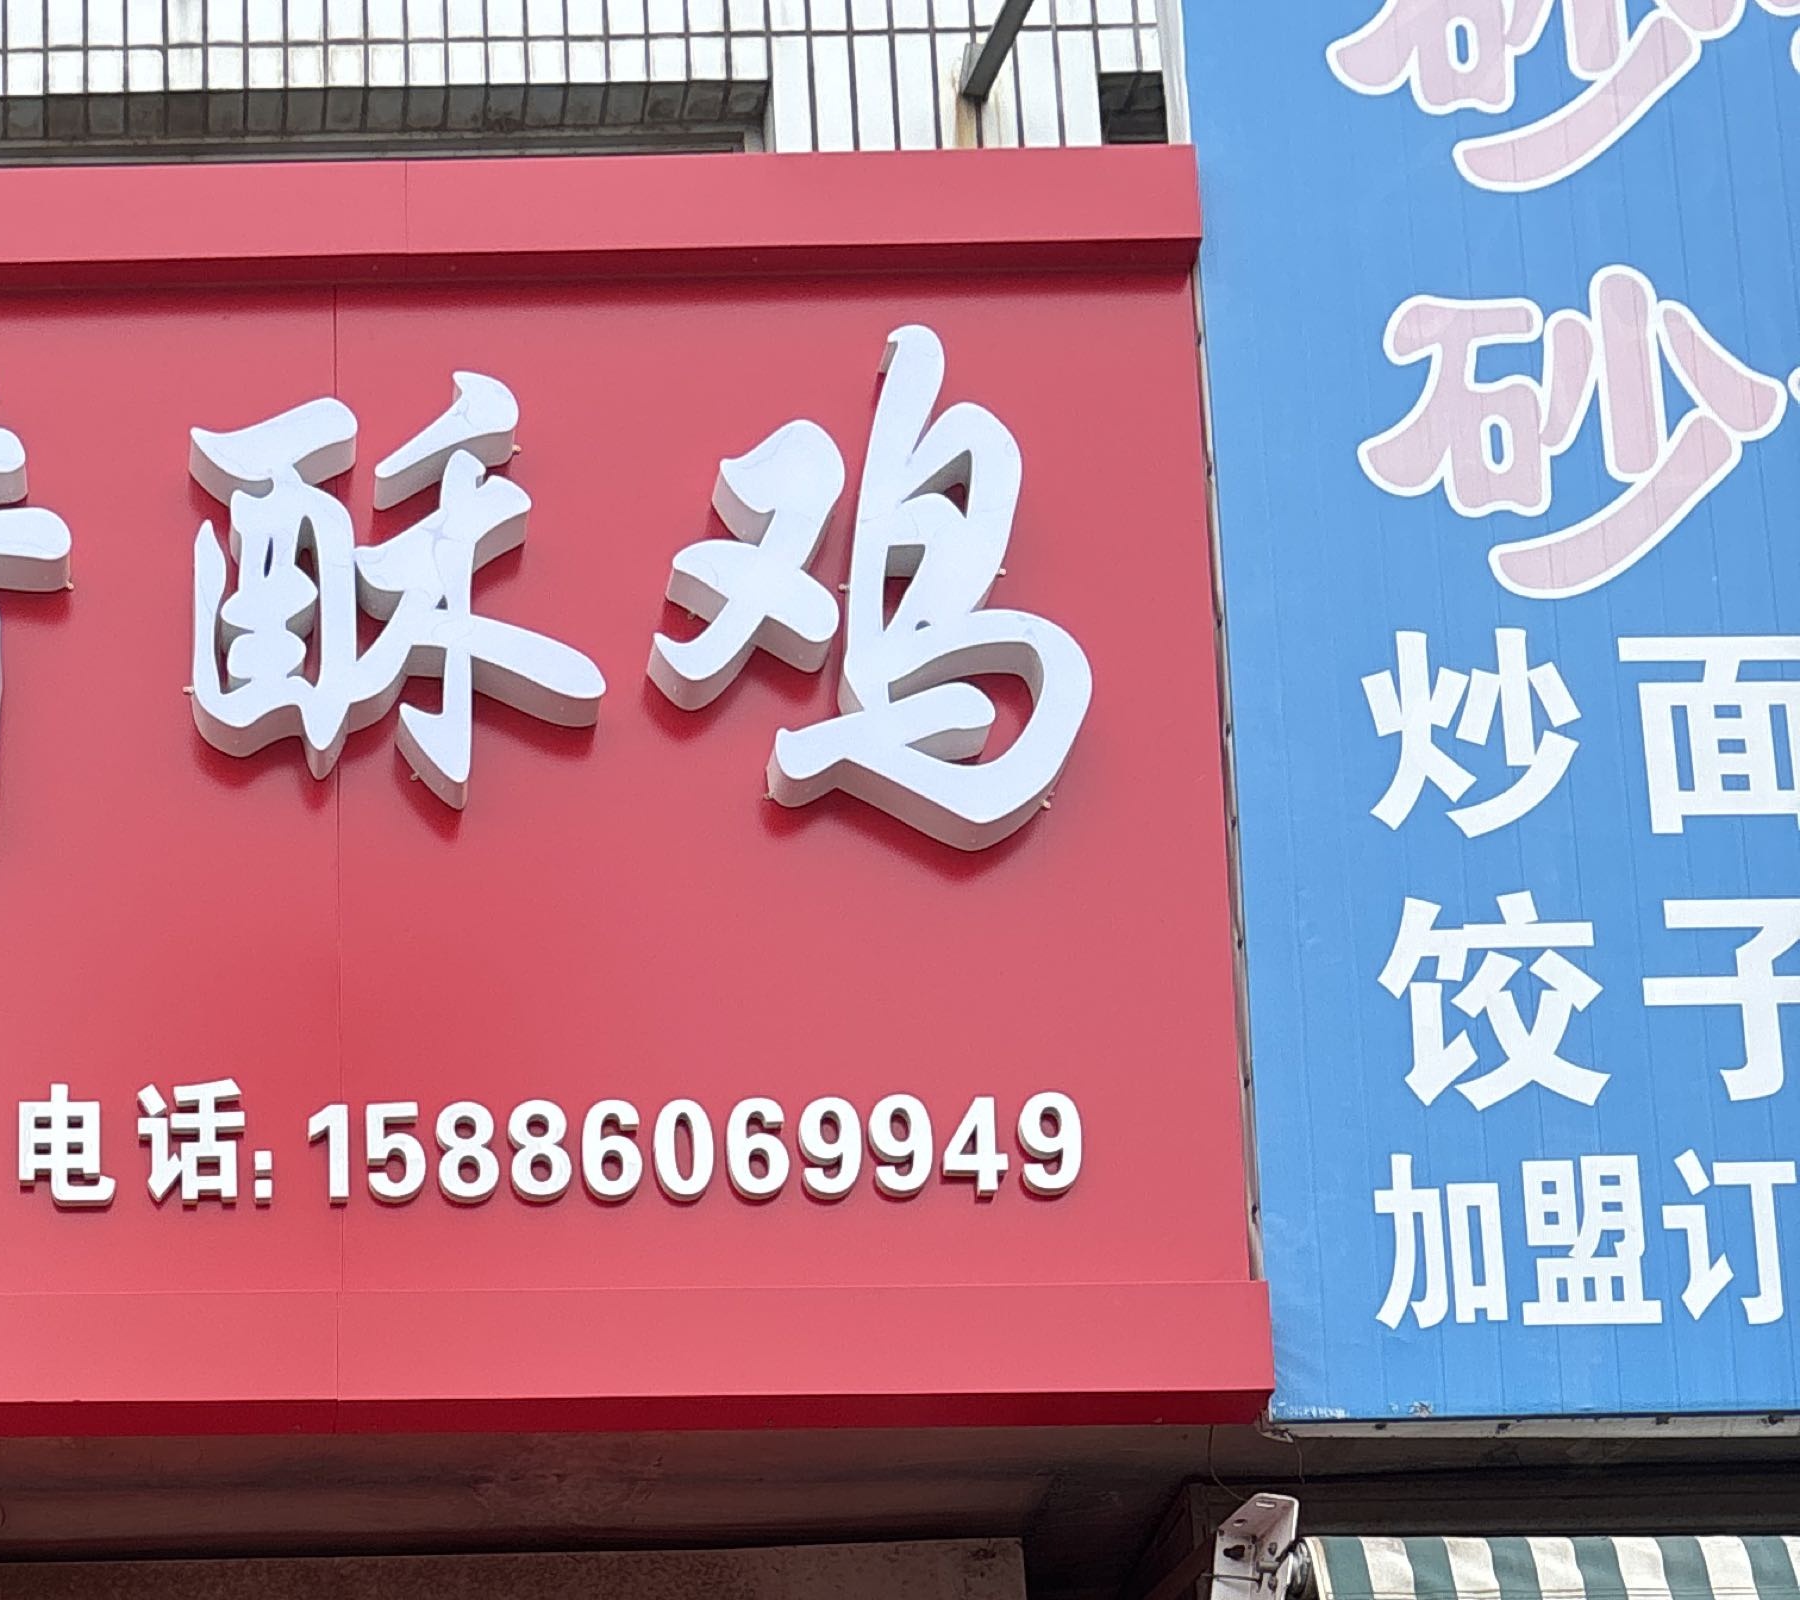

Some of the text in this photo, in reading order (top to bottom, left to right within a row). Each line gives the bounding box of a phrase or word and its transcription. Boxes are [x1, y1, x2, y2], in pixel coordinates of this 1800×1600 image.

[1326, 0, 1800, 191] 砂
[1357, 264, 1800, 599] 砂
[1362, 626, 1800, 839] 炒面
[306, 1088, 1086, 1204] 15886069949
[1373, 1148, 1798, 1330] 加盟订
